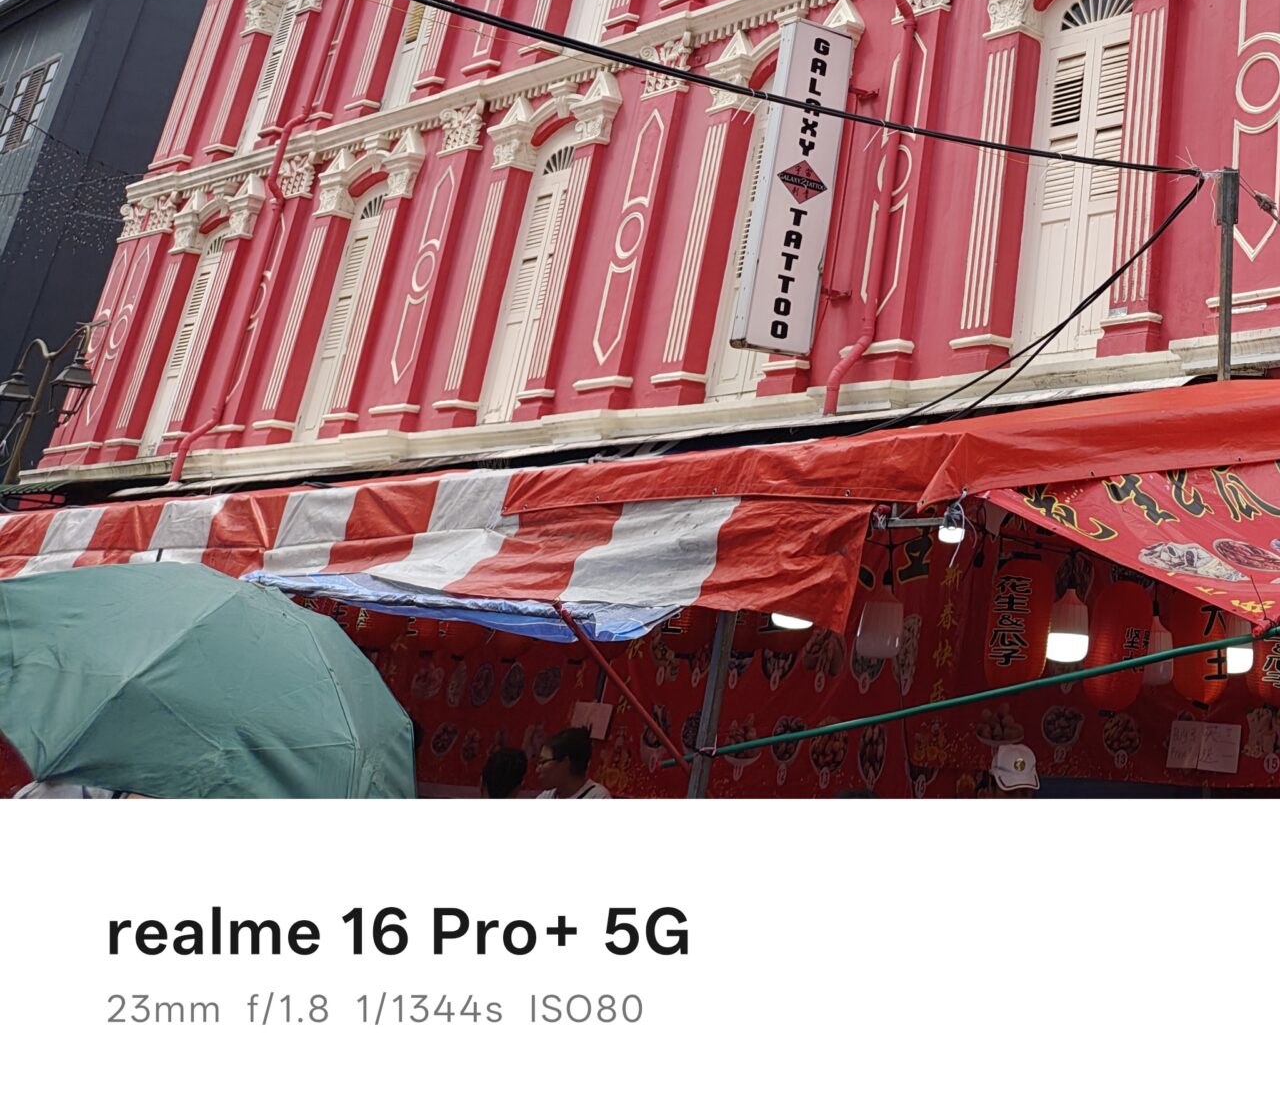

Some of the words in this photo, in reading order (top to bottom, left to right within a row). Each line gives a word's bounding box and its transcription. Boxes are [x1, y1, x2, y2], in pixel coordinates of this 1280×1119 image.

[799, 37, 831, 157] GALAXY
[770, 206, 808, 340] TATTOO
[989, 576, 1033, 667] 花生&瓜子
